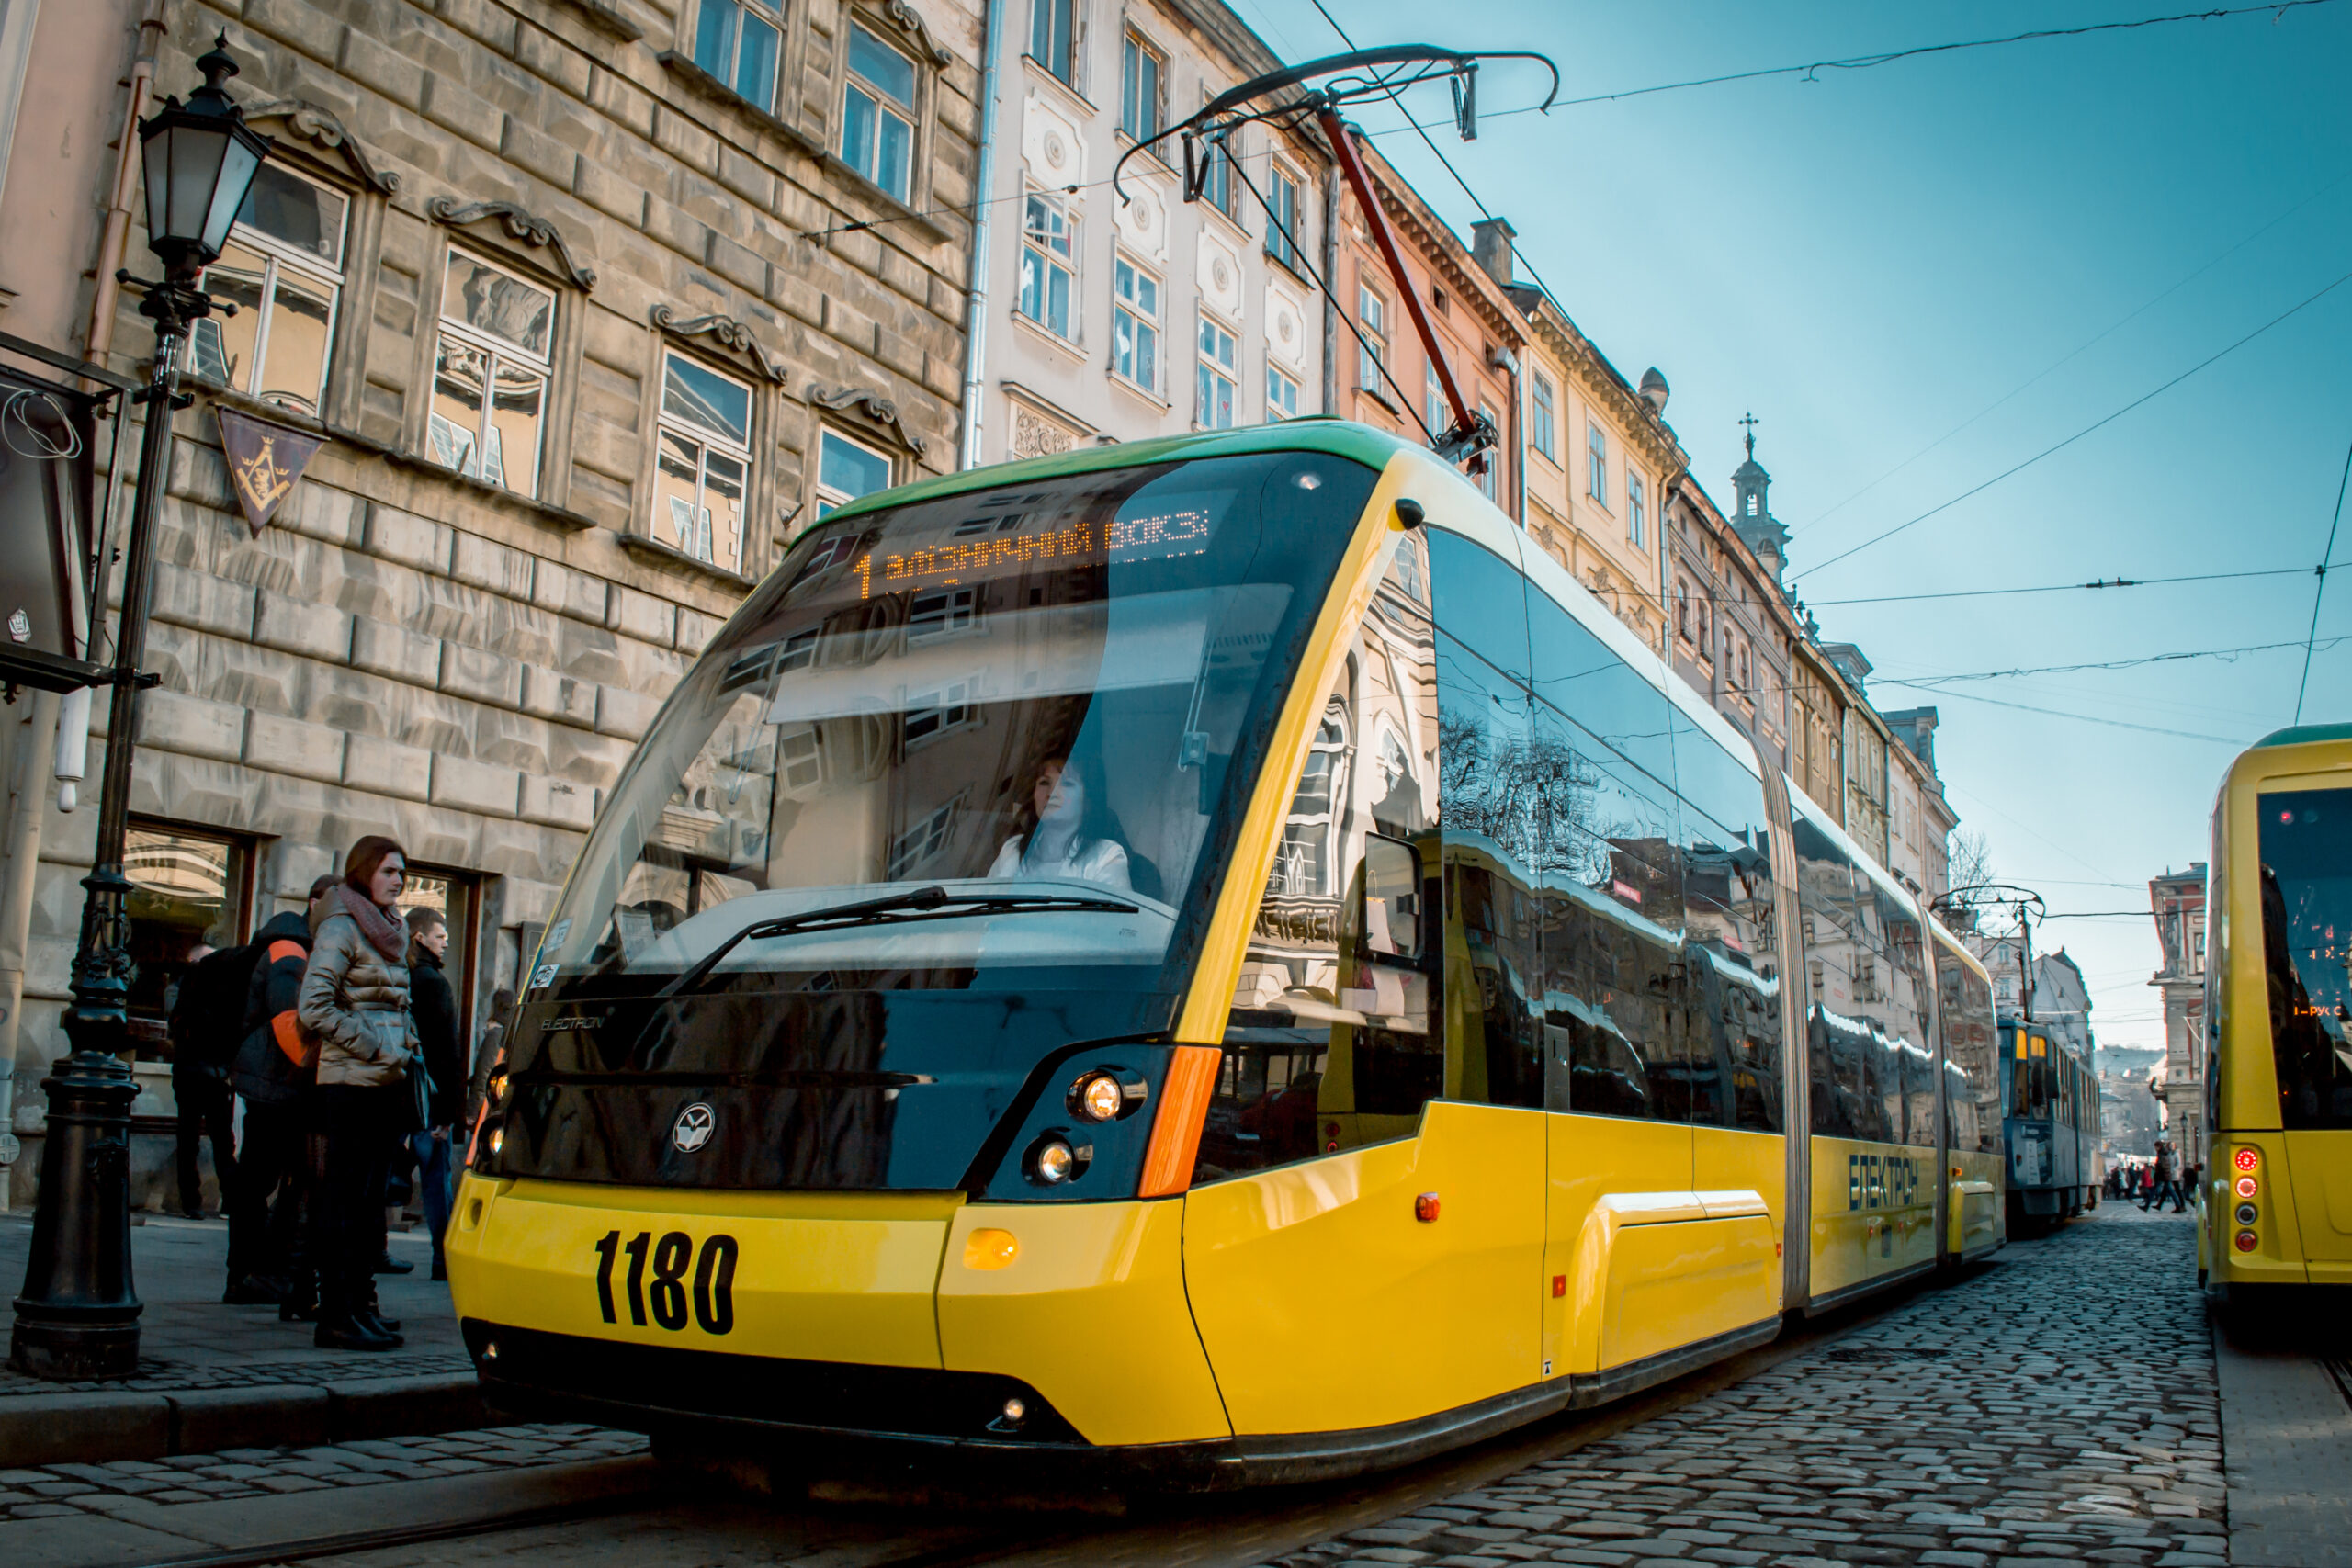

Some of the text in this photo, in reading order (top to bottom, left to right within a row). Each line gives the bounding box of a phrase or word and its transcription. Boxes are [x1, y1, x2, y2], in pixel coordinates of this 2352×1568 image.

[853, 553, 872, 600] 1
[1103, 509, 1209, 550] вокз
[1849, 1154, 1918, 1213] ЕЛЕКТРОН
[594, 1229, 740, 1337] 1180
